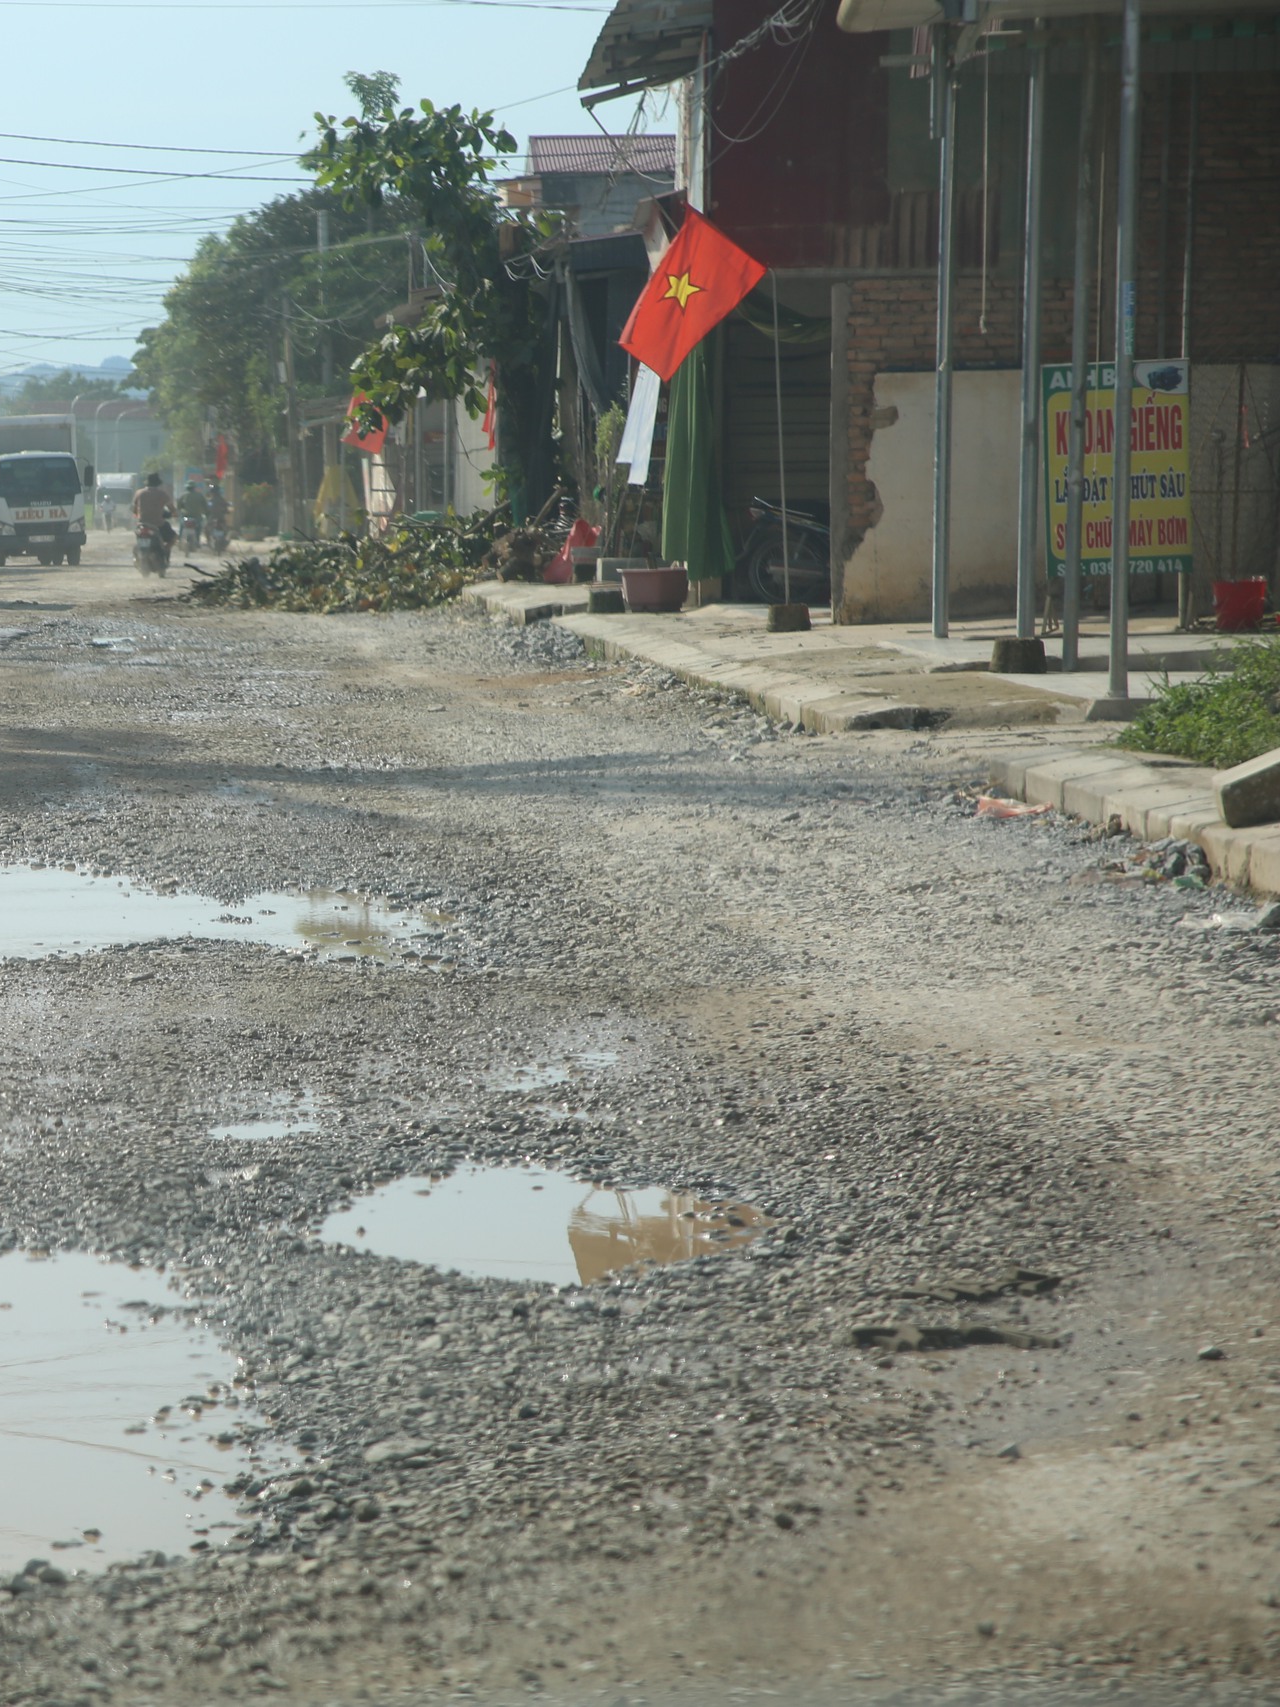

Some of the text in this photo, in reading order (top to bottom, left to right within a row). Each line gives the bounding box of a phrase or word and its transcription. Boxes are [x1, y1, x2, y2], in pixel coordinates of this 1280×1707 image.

[1055, 408, 1115, 456] KOAN
[1159, 466, 1185, 498] SÂU
[1158, 514, 1187, 546] BƠM
[1128, 560, 1154, 574] 720
